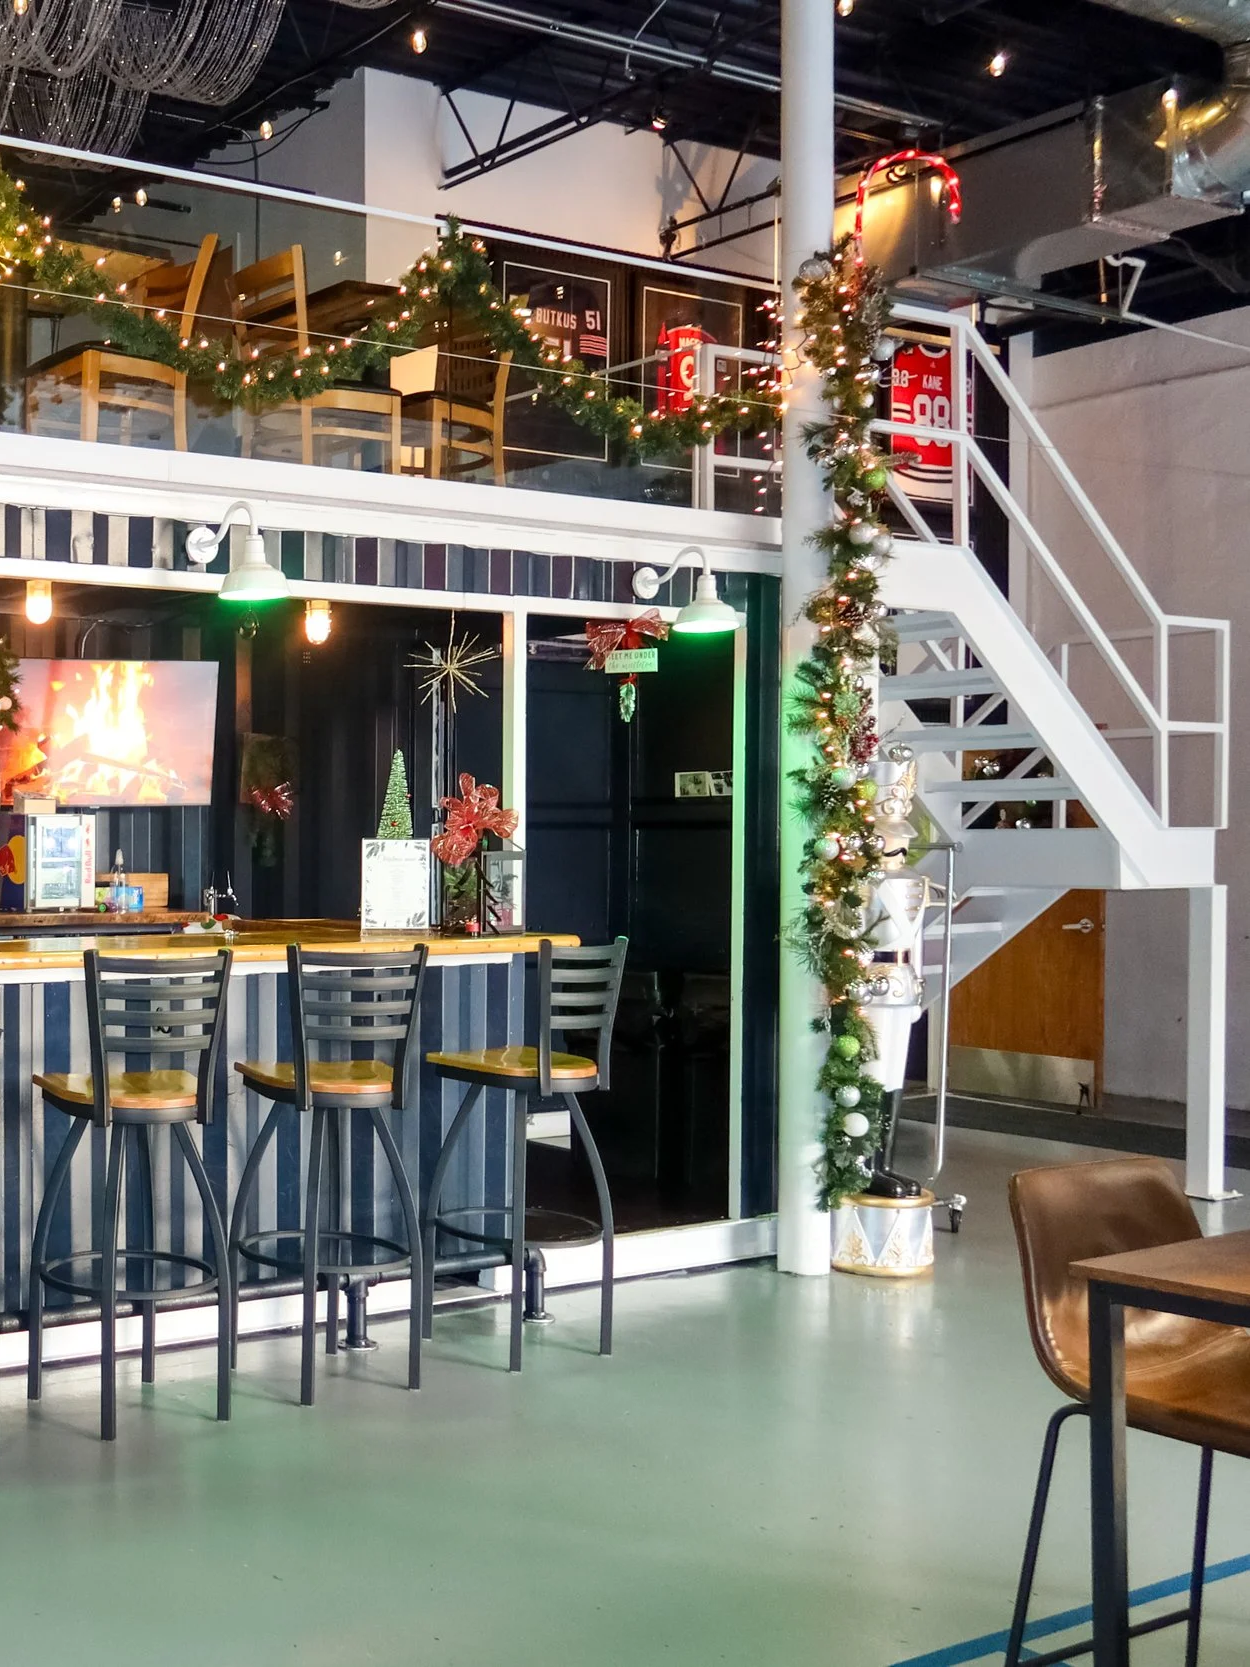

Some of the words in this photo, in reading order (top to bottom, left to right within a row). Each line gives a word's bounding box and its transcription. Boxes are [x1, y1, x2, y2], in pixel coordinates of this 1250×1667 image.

[536, 307, 577, 330] BUTKUS
[585, 310, 601, 331] 51
[922, 374, 943, 391] KANE
[913, 393, 951, 448] 88
